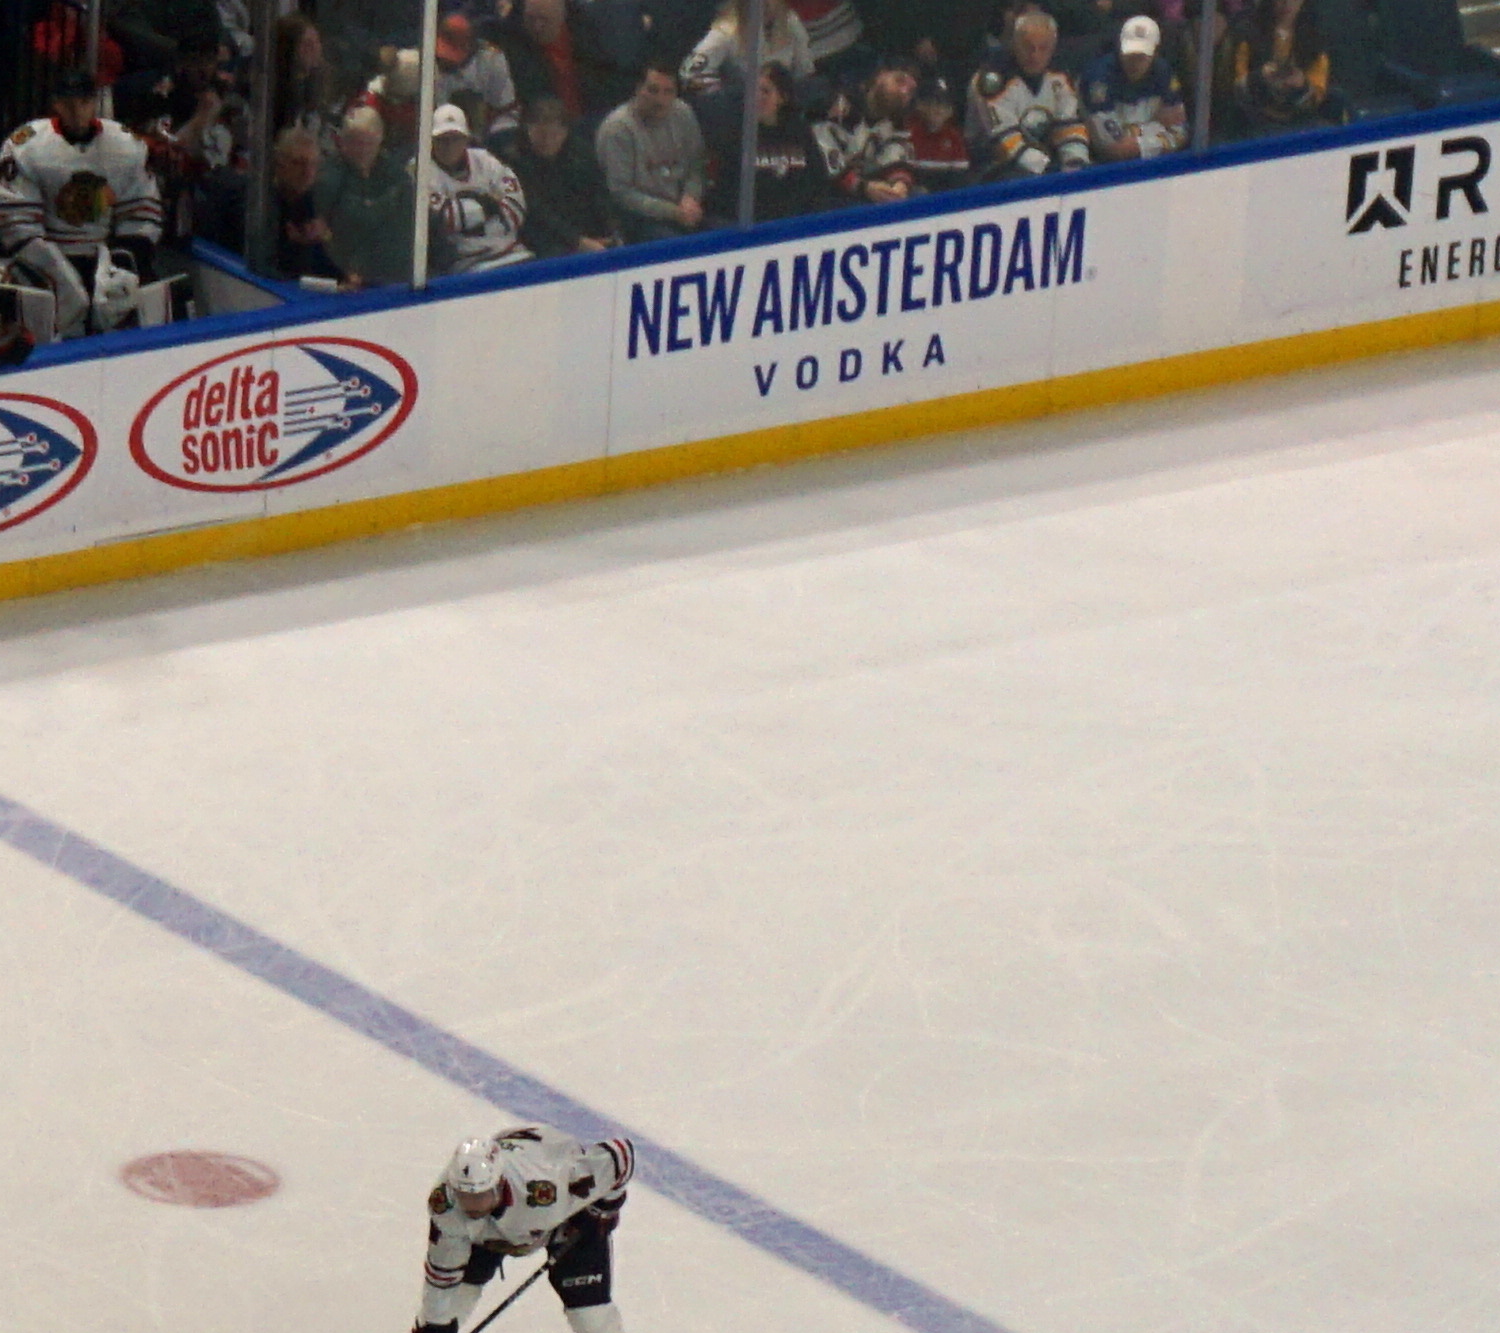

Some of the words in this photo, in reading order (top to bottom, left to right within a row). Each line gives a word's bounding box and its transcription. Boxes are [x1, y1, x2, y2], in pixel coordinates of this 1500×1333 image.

[626, 263, 746, 360] NEW
[752, 206, 1088, 338] AMSTERDAM
[181, 364, 280, 430] delta
[753, 332, 947, 398] VODKA
[181, 417, 280, 476] sonic
